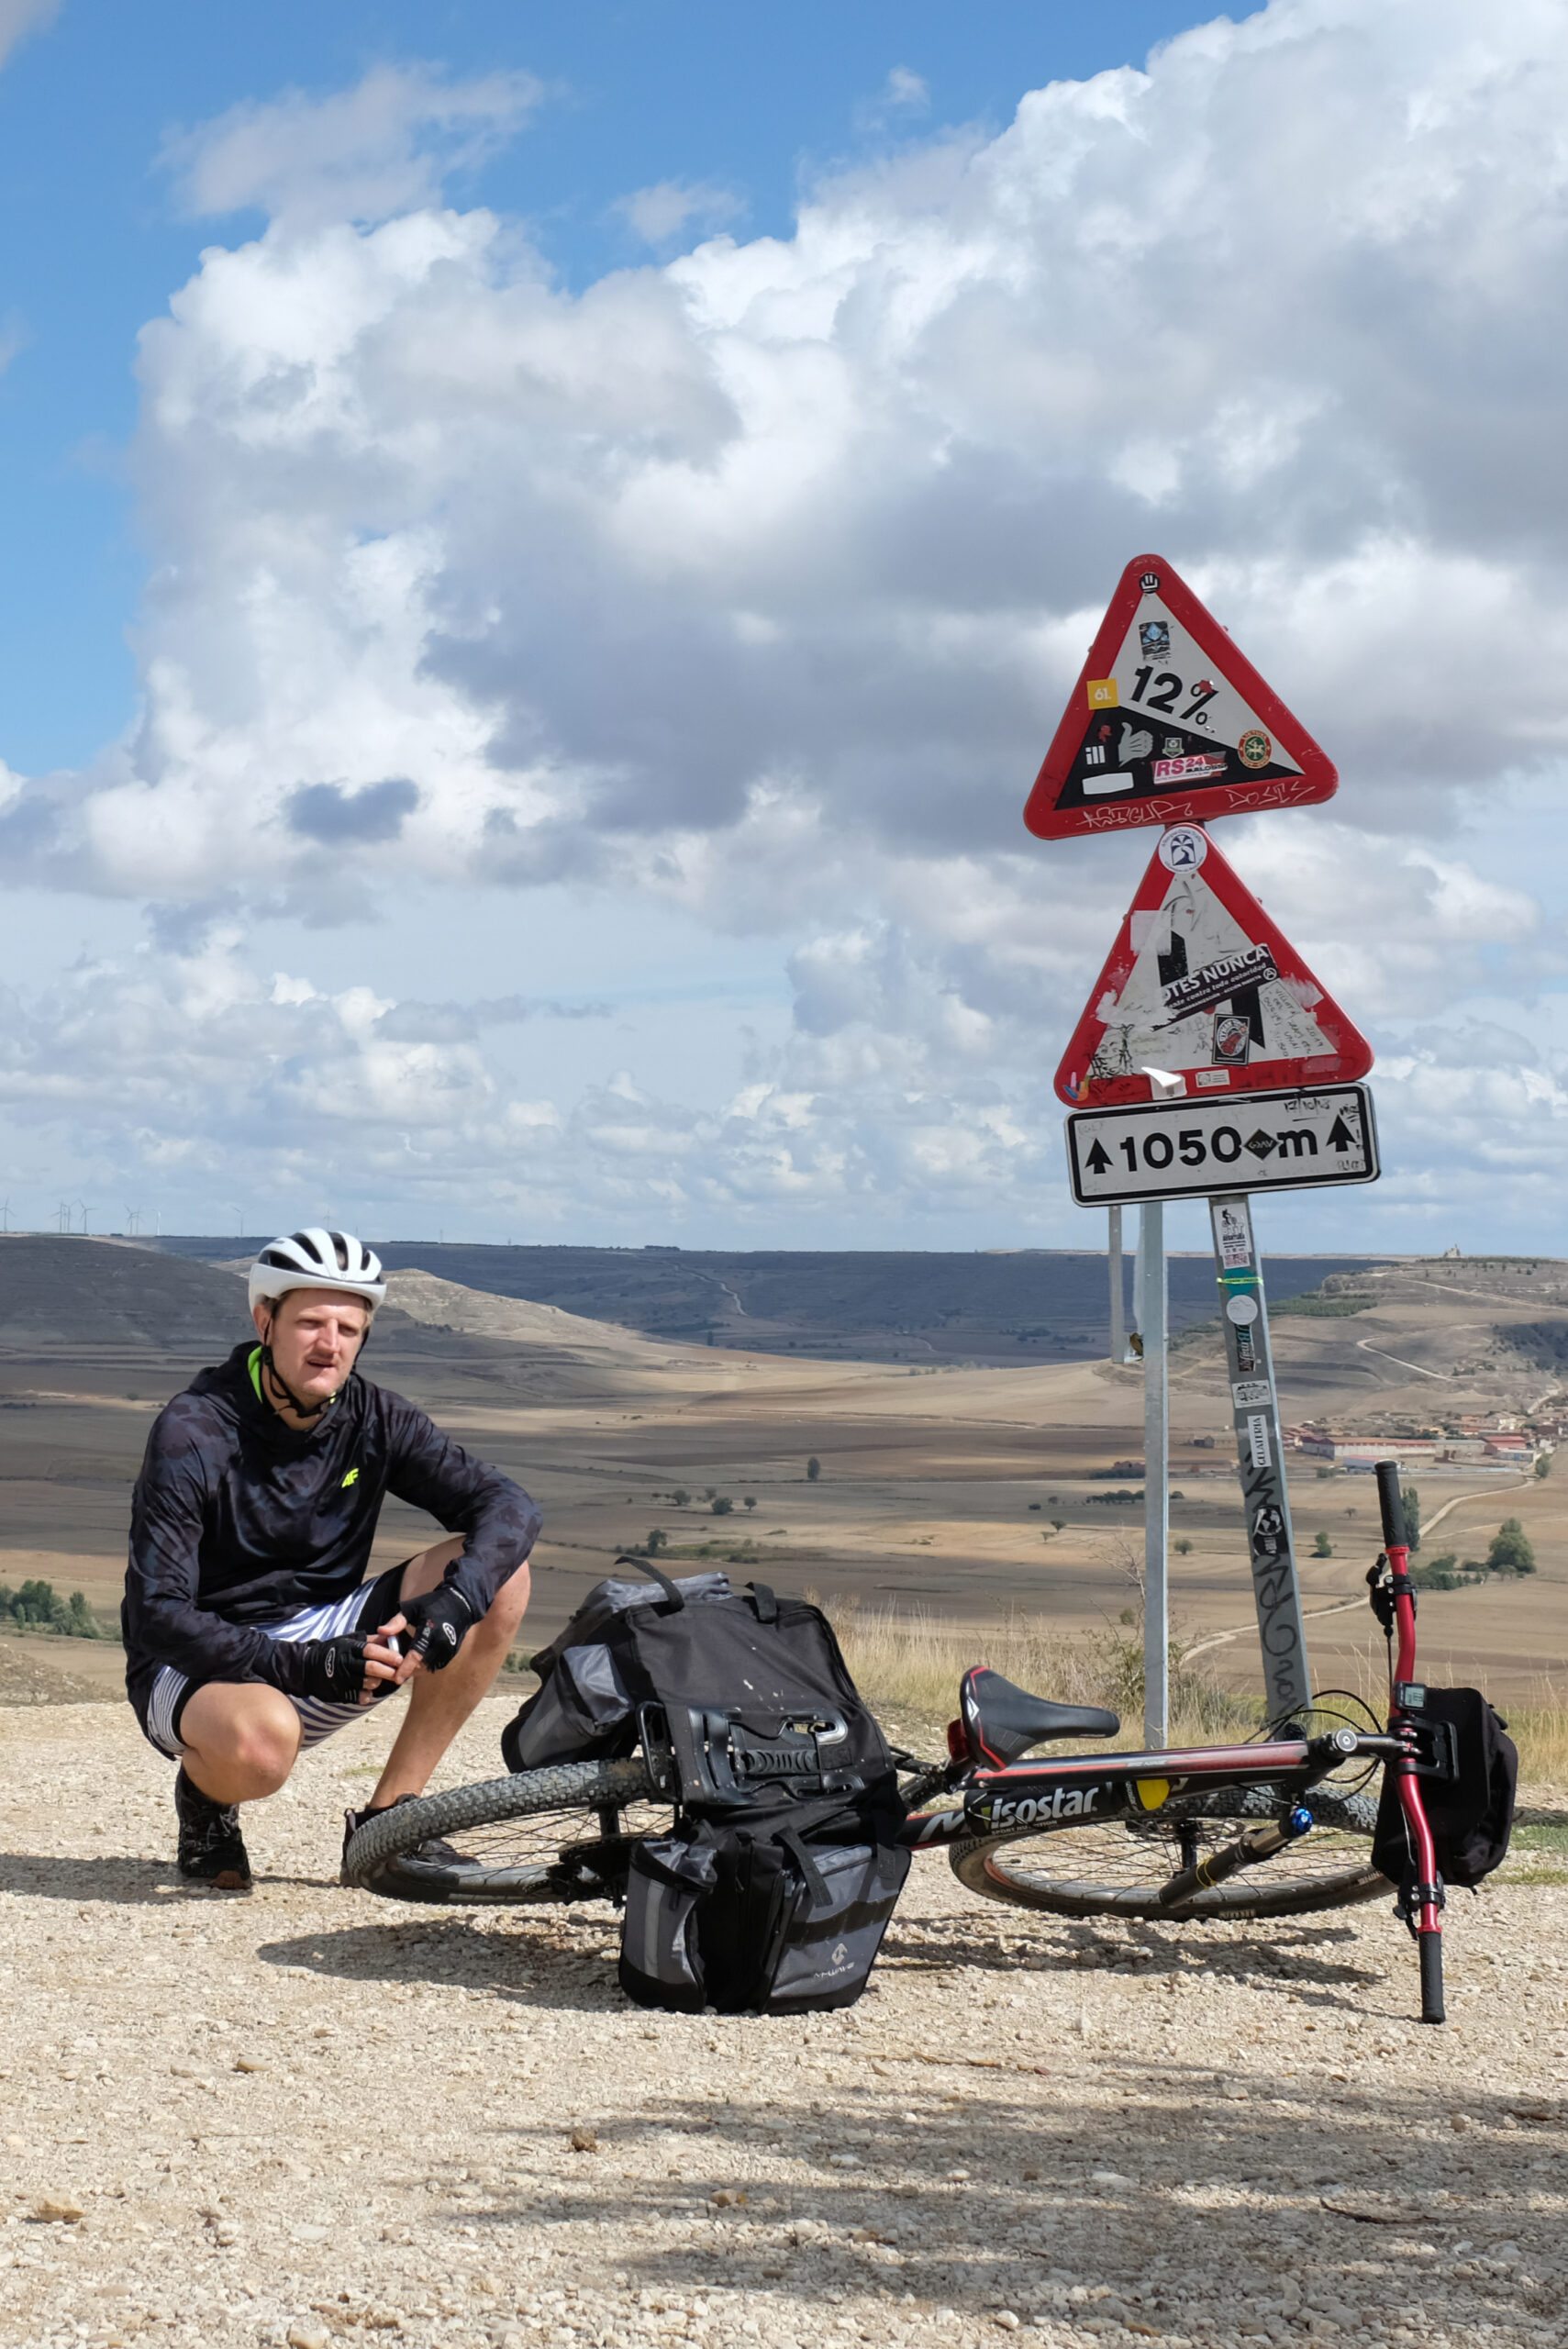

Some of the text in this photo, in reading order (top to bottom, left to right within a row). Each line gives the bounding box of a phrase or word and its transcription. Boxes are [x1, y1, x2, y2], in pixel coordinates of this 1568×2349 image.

[1129, 665, 1219, 726] 12%
[1162, 945, 1270, 1002] OTES NUNCA
[1119, 1126, 1318, 1173] 1050 m
[1252, 1417, 1266, 1466] GELATERIA
[991, 1787, 1099, 1830] isostar
